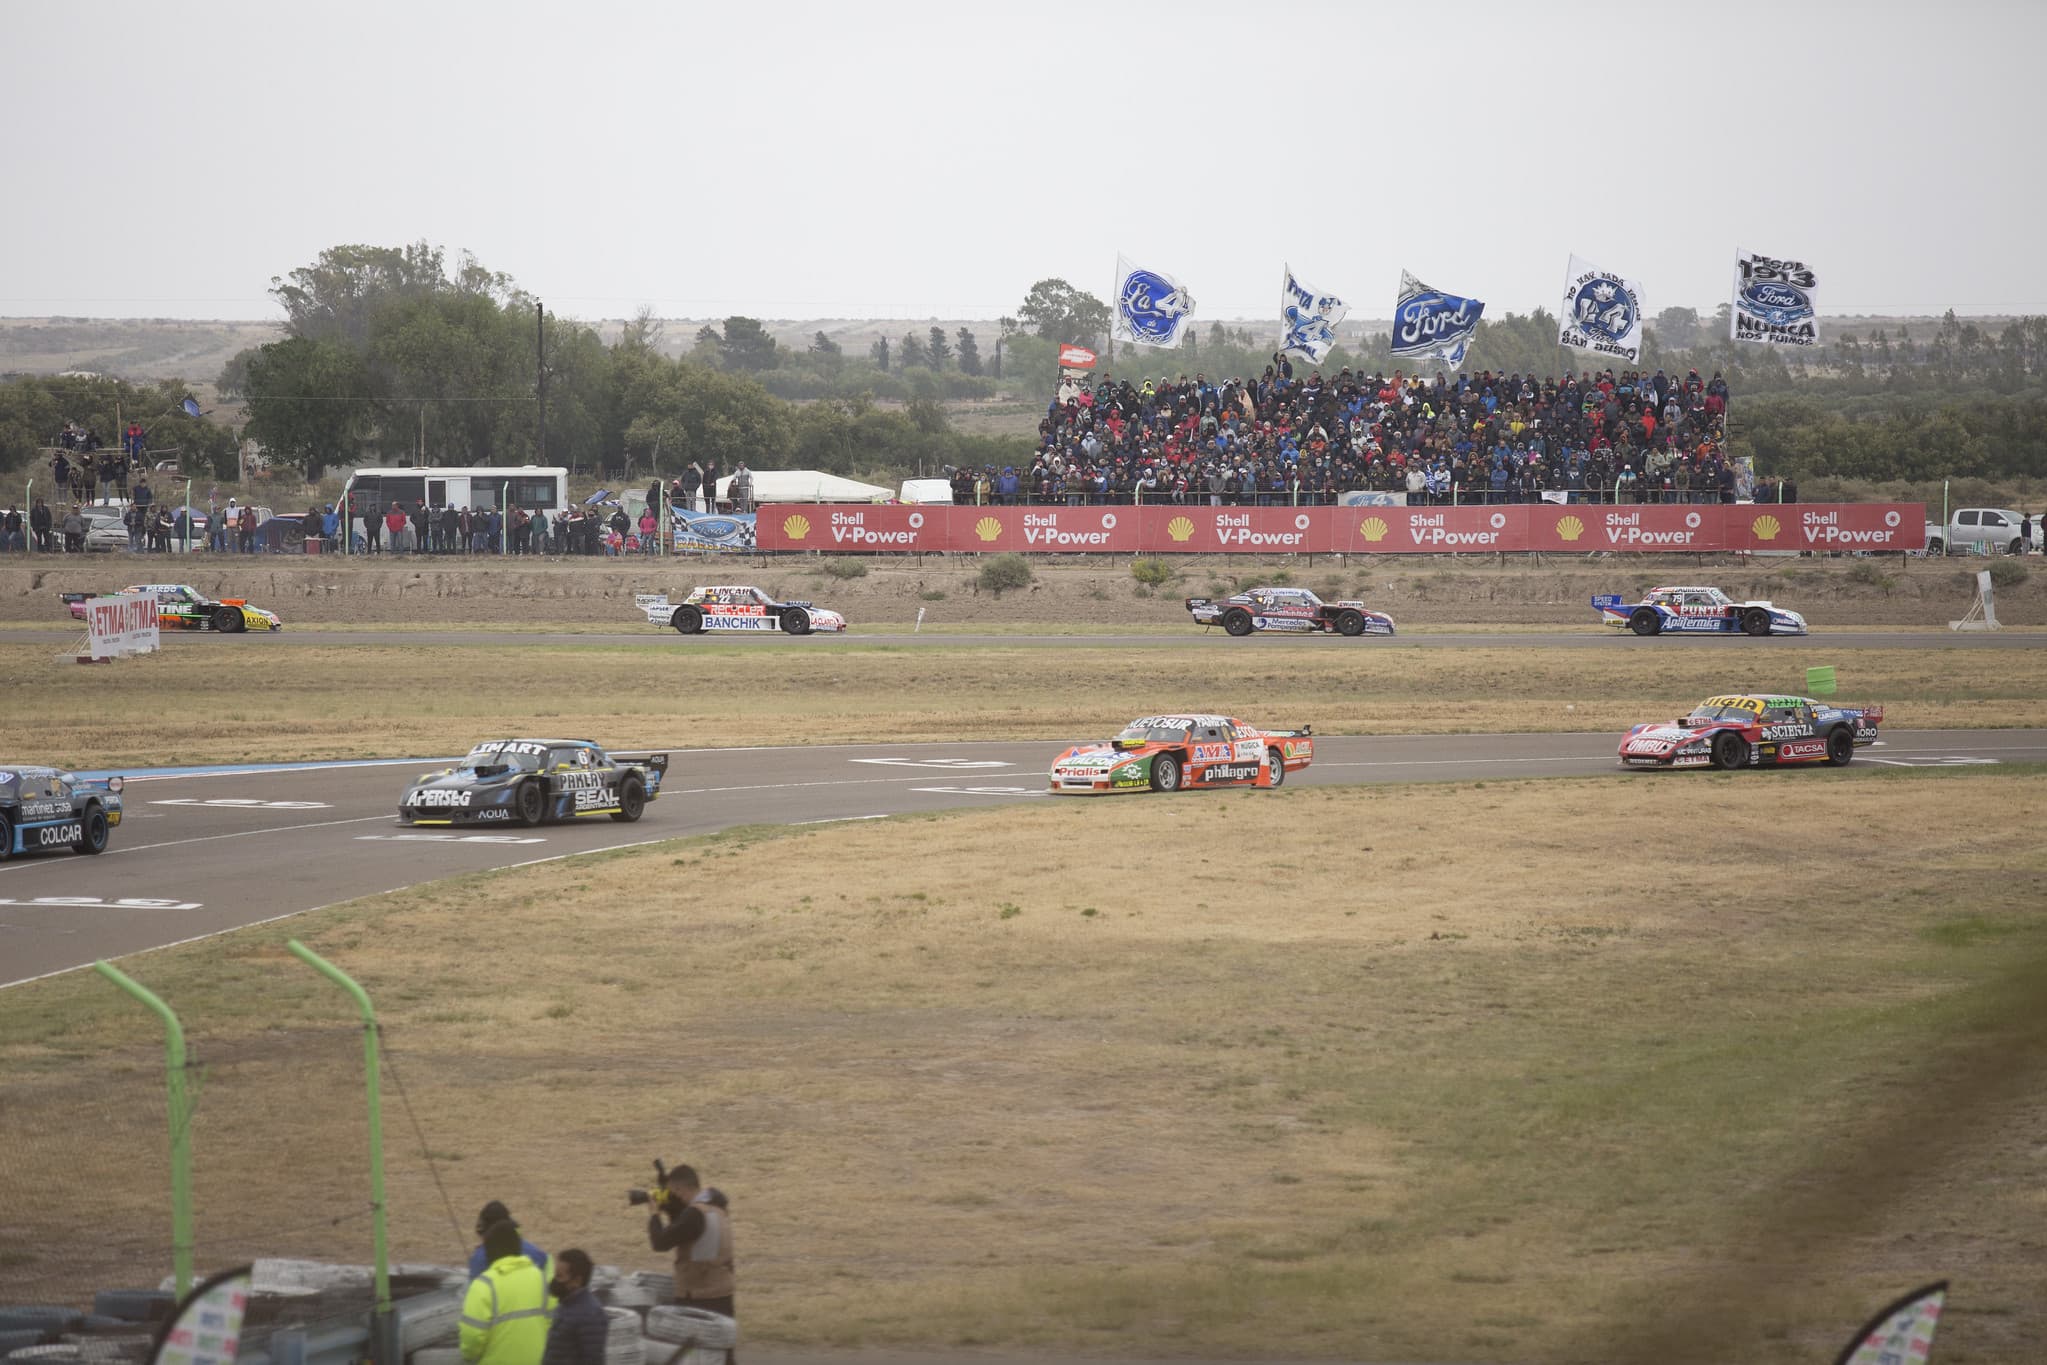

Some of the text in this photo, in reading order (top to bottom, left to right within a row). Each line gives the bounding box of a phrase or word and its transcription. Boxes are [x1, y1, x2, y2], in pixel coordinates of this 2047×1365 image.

[1752, 254, 1805, 271] DESDE
[1738, 259, 1816, 288] 1913
[1757, 286, 1796, 306] Ford
[1402, 297, 1470, 343] Ford
[1737, 312, 1815, 338] NUNCA
[1737, 331, 1813, 346] NOS FUIMOS
[831, 512, 864, 525] Shell
[1023, 513, 1057, 527] Shell
[1216, 513, 1250, 527] Shell
[1409, 513, 1444, 527] Shell
[1606, 512, 1640, 526] Shell
[1803, 511, 1837, 525] Shell
[831, 526, 918, 543] V-Power
[1023, 527, 1111, 544] V-Power
[1216, 528, 1304, 545] V-Power
[1409, 527, 1500, 545] V-Power
[1605, 526, 1695, 544] V-Power
[1803, 526, 1894, 543] V-Power
[158, 604, 193, 614] TINE
[1680, 606, 1725, 616] PUNTE
[96, 604, 125, 637] ETMA
[246, 616, 269, 626] AXION
[705, 617, 760, 630] BANCHIK
[1271, 618, 1307, 627] Mercedes
[1771, 724, 1815, 738] SCIENZA
[1794, 743, 1825, 754] TACSA
[577, 751, 588, 765] 6
[1059, 767, 1100, 776] Prialis
[1204, 764, 1260, 783] philagro
[559, 772, 605, 791] PAKLAY
[406, 789, 473, 807] APERSEG
[575, 788, 620, 804] SEAL
[478, 808, 510, 819] AQUA
[40, 825, 82, 846] COLCAR
